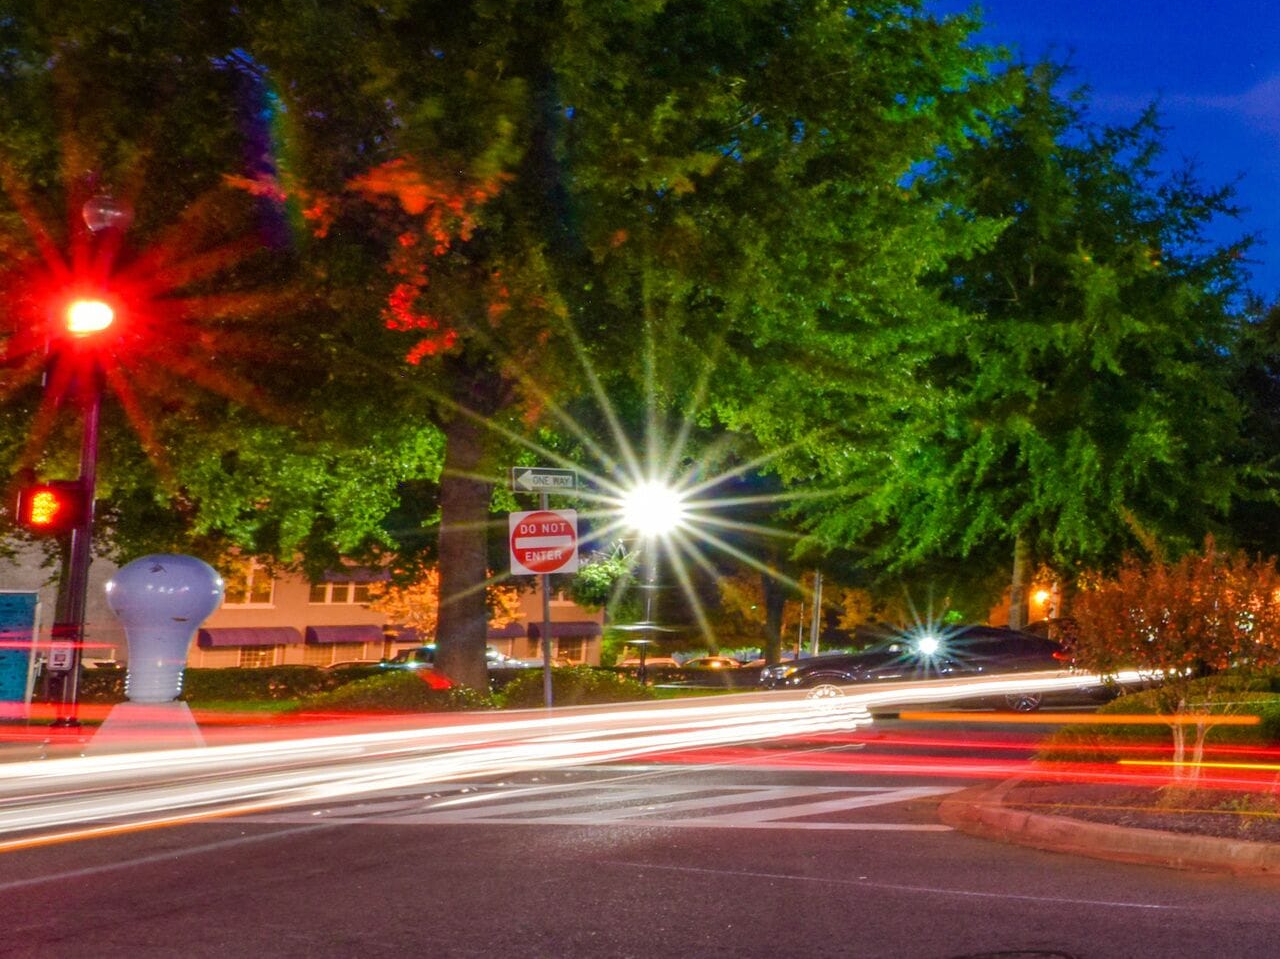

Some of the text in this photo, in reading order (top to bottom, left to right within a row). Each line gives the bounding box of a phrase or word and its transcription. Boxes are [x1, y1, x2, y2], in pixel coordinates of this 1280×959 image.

[532, 475, 570, 486] ONE WAY
[520, 522, 566, 535] DO NOT
[525, 550, 562, 562] ENTER
